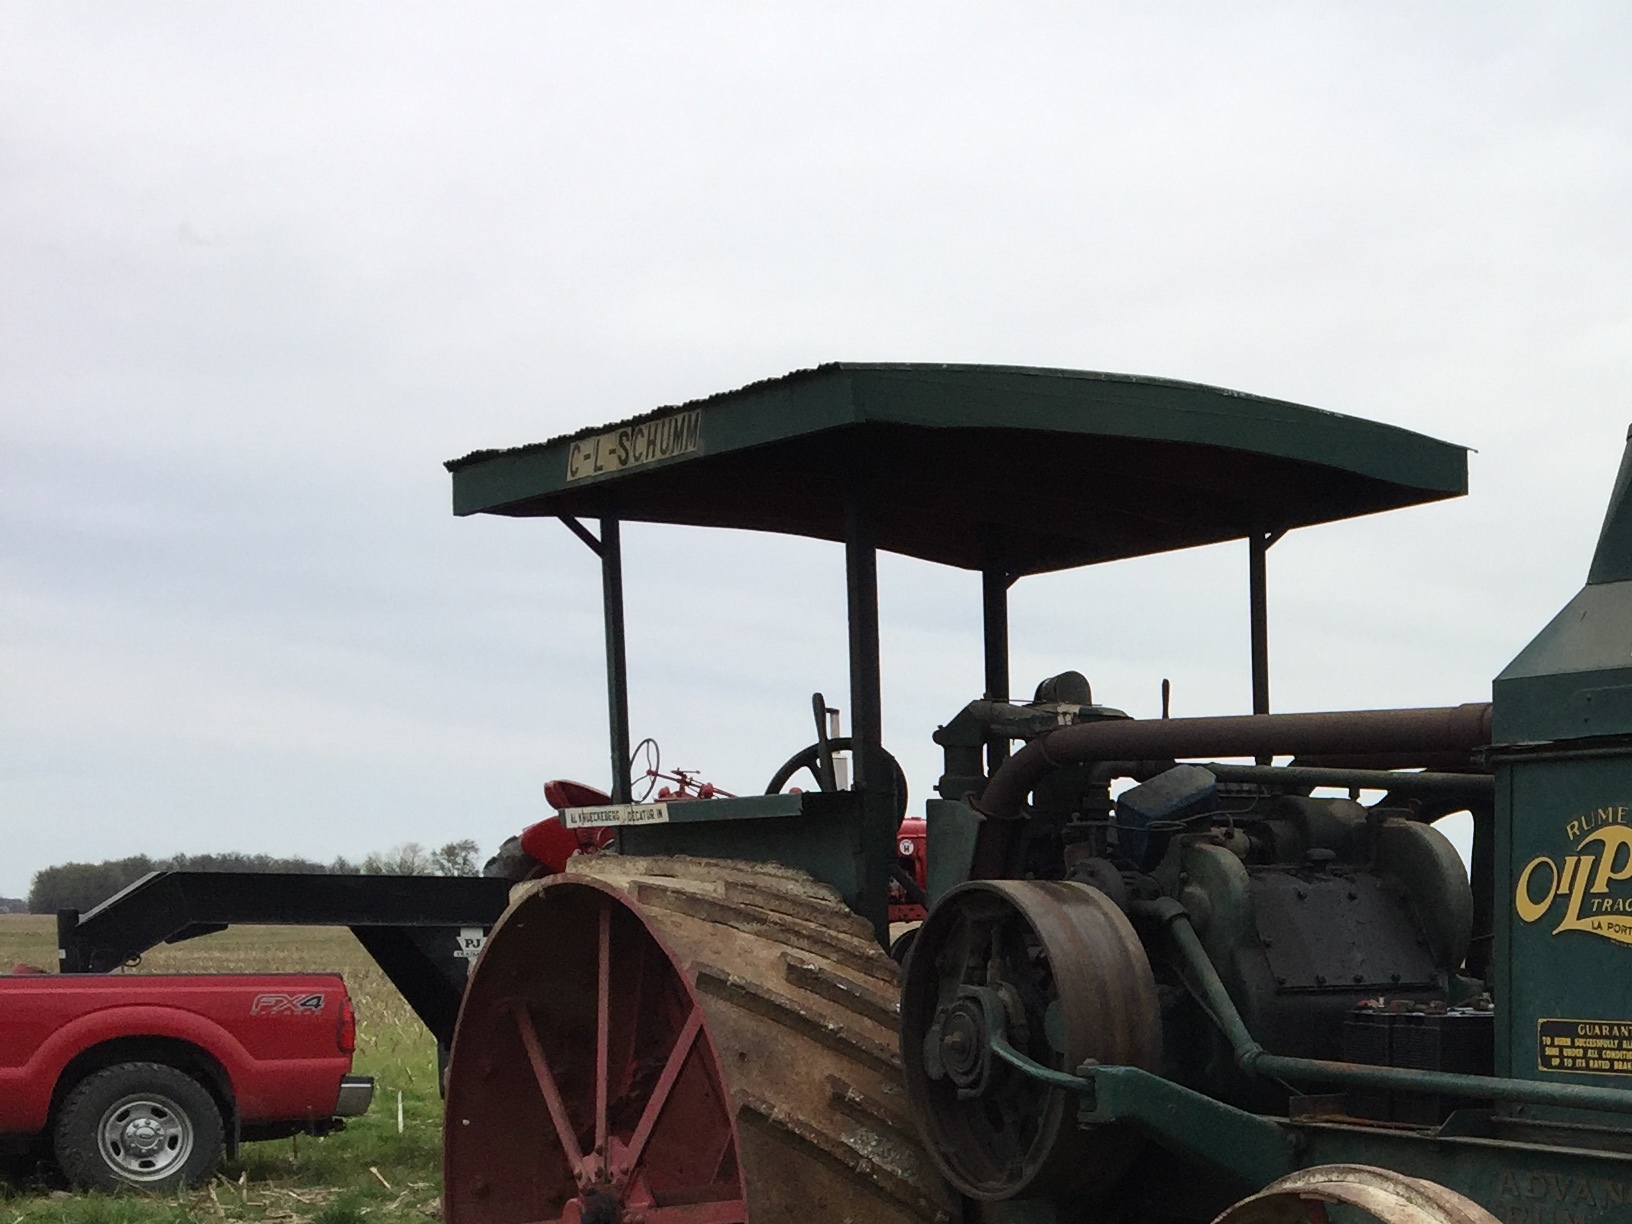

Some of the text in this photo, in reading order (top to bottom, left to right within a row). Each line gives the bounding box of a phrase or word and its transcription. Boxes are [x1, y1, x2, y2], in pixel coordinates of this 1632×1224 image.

[656, 808, 663, 819] IN
[1591, 920, 1603, 931] LA
[465, 938, 481, 948] PJ
[250, 993, 325, 1015] FX4
[1542, 1036, 1551, 1045] TO
[1588, 1049, 1598, 1058] ALL
[1551, 1057, 1560, 1066] UP
[1564, 1058, 1572, 1067] TO
